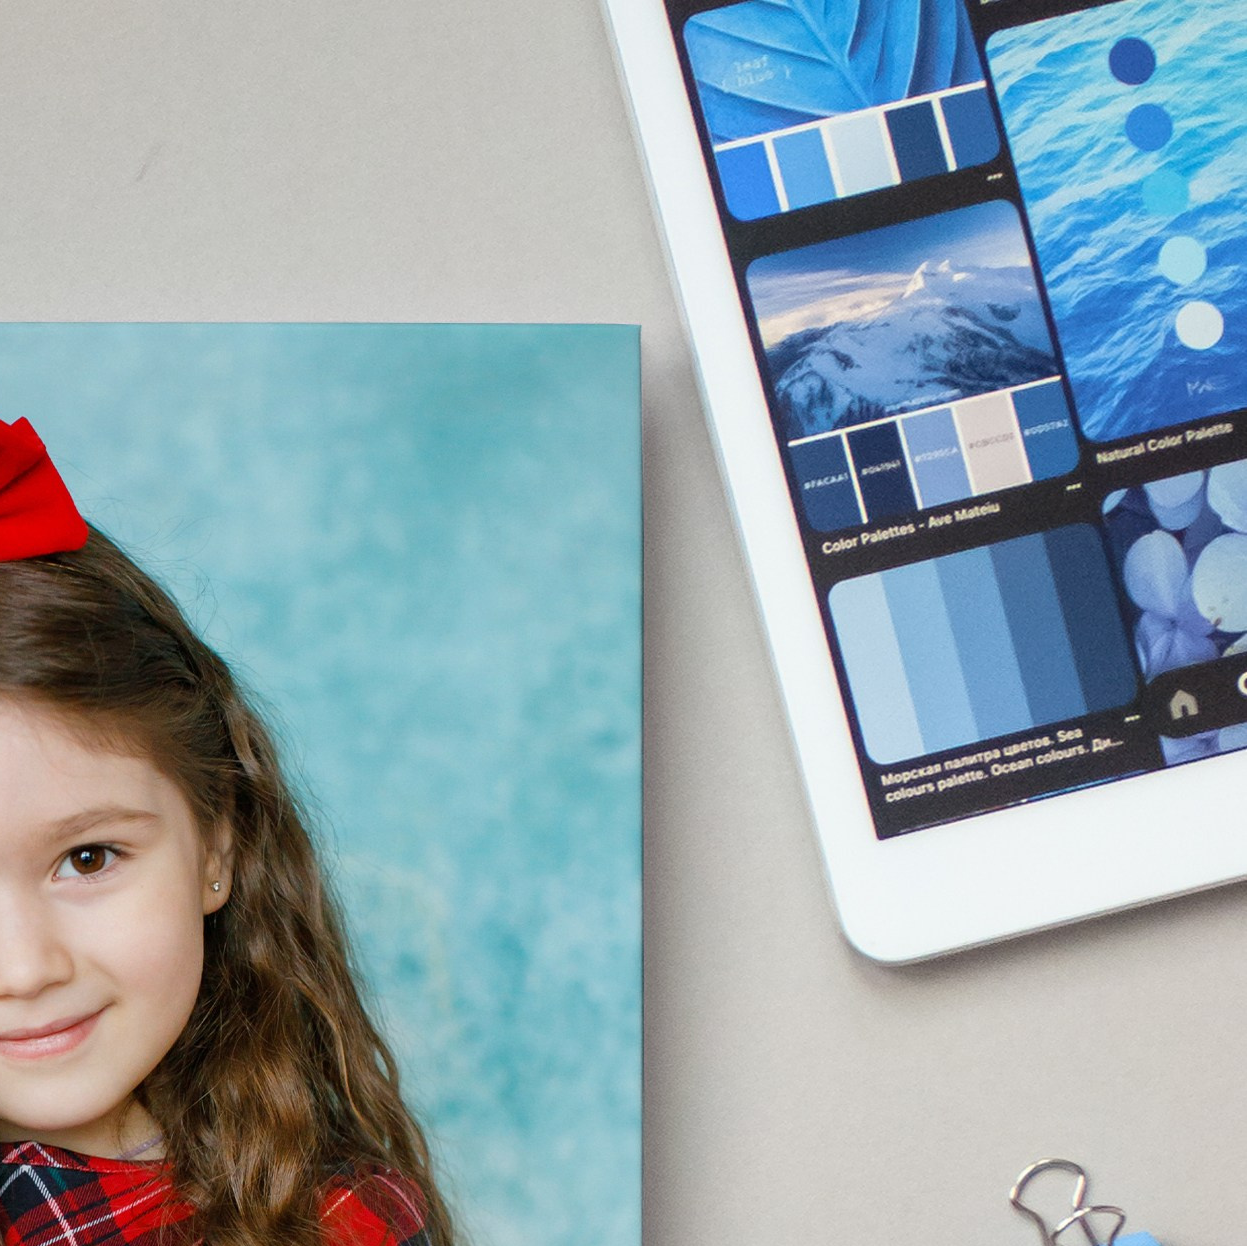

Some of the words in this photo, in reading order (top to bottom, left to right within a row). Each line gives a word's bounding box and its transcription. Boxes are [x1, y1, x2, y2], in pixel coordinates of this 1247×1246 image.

[1096, 442, 1146, 464] Natural
[1148, 434, 1183, 451] Color
[1186, 422, 1234, 442] Palette
[821, 534, 858, 555] Color
[861, 522, 916, 545] Palettes
[928, 512, 953, 529] Ave
[954, 502, 1001, 522] Mateiu
[880, 763, 942, 787] Морская
[944, 749, 1001, 771] палитра
[1003, 736, 1054, 757] цветов.
[1056, 727, 1083, 743] Sea
[884, 782, 936, 803] colours
[937, 769, 989, 792] palette.
[990, 758, 1034, 777] Ocean
[1036, 746, 1090, 765] colours.
